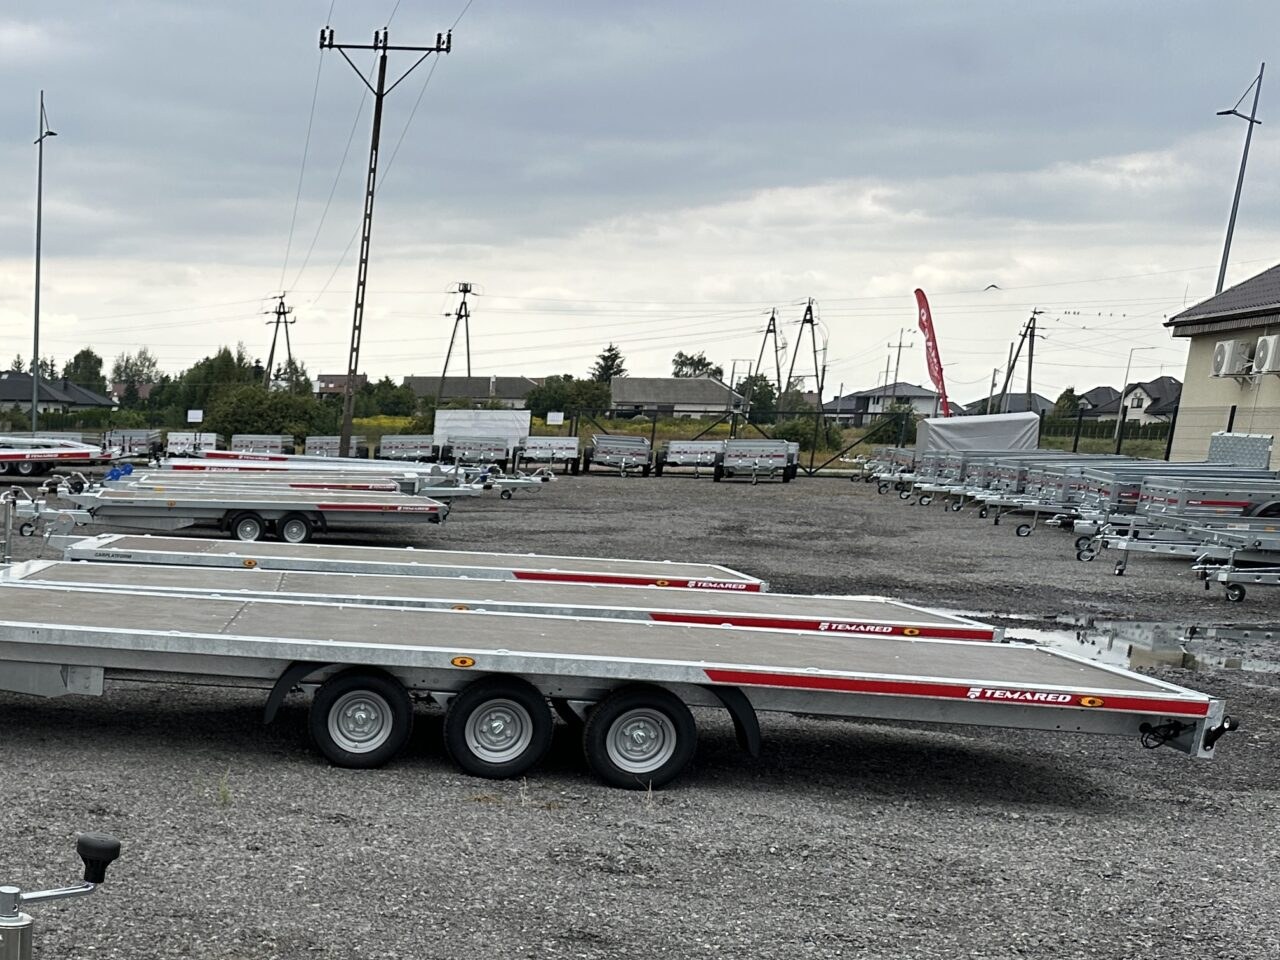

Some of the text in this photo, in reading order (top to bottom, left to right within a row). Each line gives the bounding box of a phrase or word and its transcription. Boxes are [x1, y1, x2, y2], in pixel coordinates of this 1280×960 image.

[696, 581, 747, 590] TEMARED
[830, 623, 893, 633] TEMARED
[984, 689, 1072, 703] TEMARED
